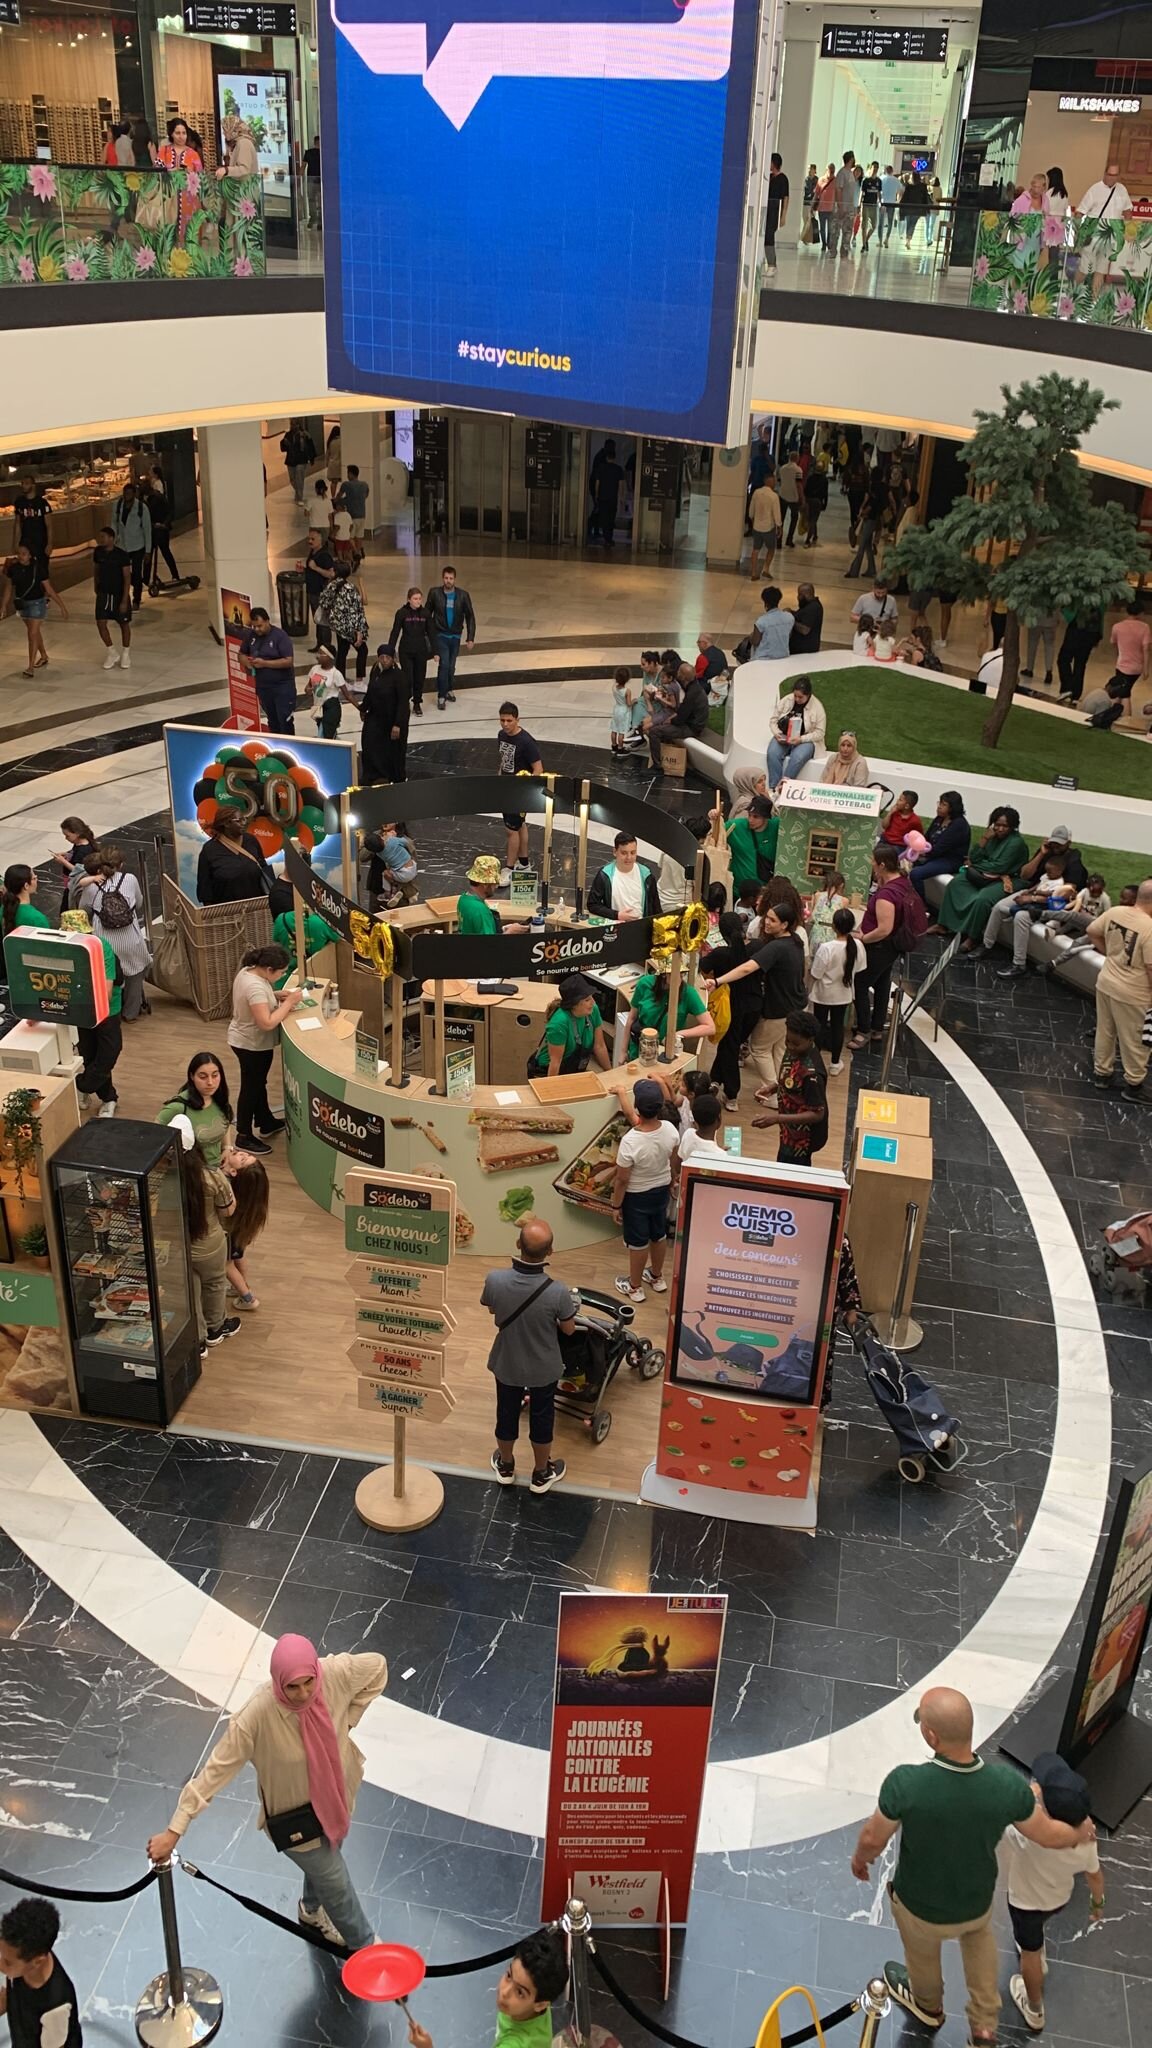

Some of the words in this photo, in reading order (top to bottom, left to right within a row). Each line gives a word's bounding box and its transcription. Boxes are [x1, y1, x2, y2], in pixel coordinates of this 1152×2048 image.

[185, 7, 193, 25] 1
[824, 31, 833, 50] 1
[1059, 97, 1140, 113] MILKSHAKES
[458, 340, 571, 372] #staycurious
[786, 785, 807, 801] ici
[811, 788, 874, 801] PERSONNALISEZ
[809, 796, 832, 805] VOTRE
[834, 799, 872, 809] TOTEBAG
[311, 880, 341, 918] Sodebo
[651, 901, 710, 959] 50
[350, 910, 393, 978] 50
[531, 936, 604, 964] Sodebo
[547, 966, 569, 975] nourrir
[29, 971, 58, 992] 50
[446, 1025, 467, 1035] debo
[312, 1097, 367, 1139] Sodebo
[368, 1190, 419, 1209] Sodebo
[730, 1202, 793, 1223] MEMO
[356, 1215, 441, 1244] Bienvenue
[723, 1215, 797, 1236] CUISTO
[365, 1236, 392, 1250] CHEZ
[393, 1240, 423, 1254] NOUS
[714, 1242, 740, 1256] Jeu
[741, 1249, 799, 1266] concours
[378, 1275, 411, 1287] OFFERTE
[715, 1270, 753, 1282] CHOISISSEZ
[380, 1284, 405, 1297] Miam
[385, 1307, 420, 1317] ATELIER
[708, 1304, 741, 1315] RETROUVEZ
[385, 1314, 407, 1324] VOTRE
[378, 1323, 418, 1339] Chouette
[384, 1355, 395, 1364] 50
[396, 1357, 412, 1367] ANS
[379, 1363, 409, 1377] Cheese
[369, 1382, 385, 1390] DES
[389, 1386, 429, 1398] CADEAUX
[381, 1400, 410, 1414] Super
[387, 1393, 418, 1406] GAGNER
[567, 1718, 643, 1738] JOURNÉES
[566, 1739, 653, 1757] NATIONALES
[565, 1758, 621, 1775] CONTRE
[563, 1776, 581, 1793] LA
[582, 1774, 650, 1793] LEUCÉMIE
[589, 1875, 648, 1889] Westfield
